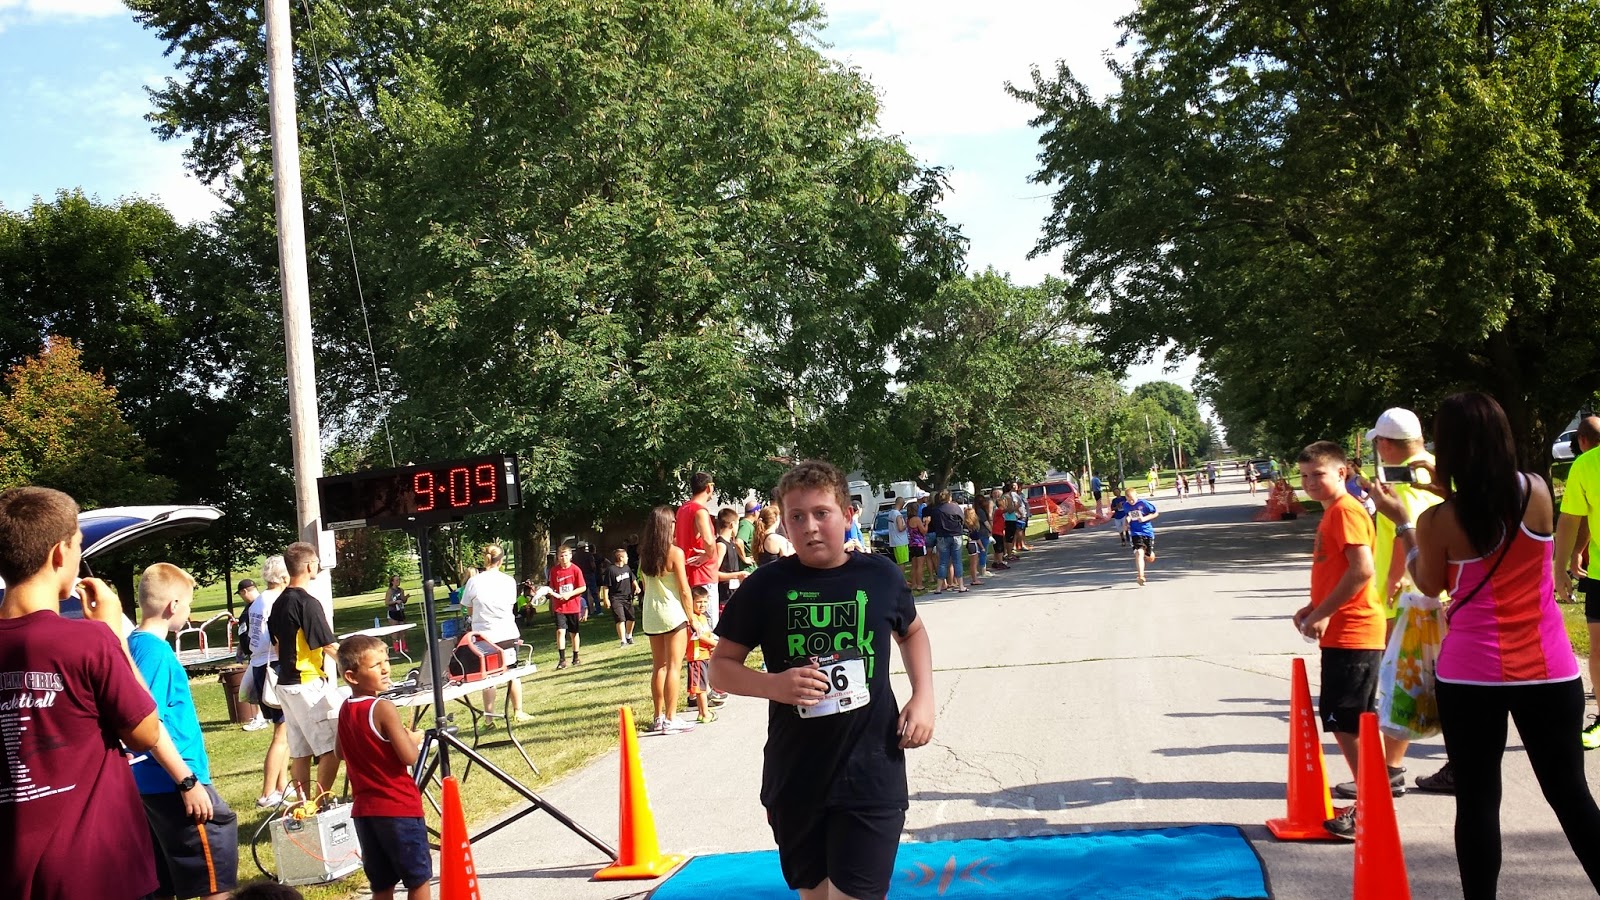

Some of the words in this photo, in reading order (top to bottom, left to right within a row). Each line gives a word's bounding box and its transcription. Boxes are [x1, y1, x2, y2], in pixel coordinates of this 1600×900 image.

[787, 604, 857, 630] RUN
[787, 630, 875, 657] ROCK
[25, 671, 64, 691] GIRLS
